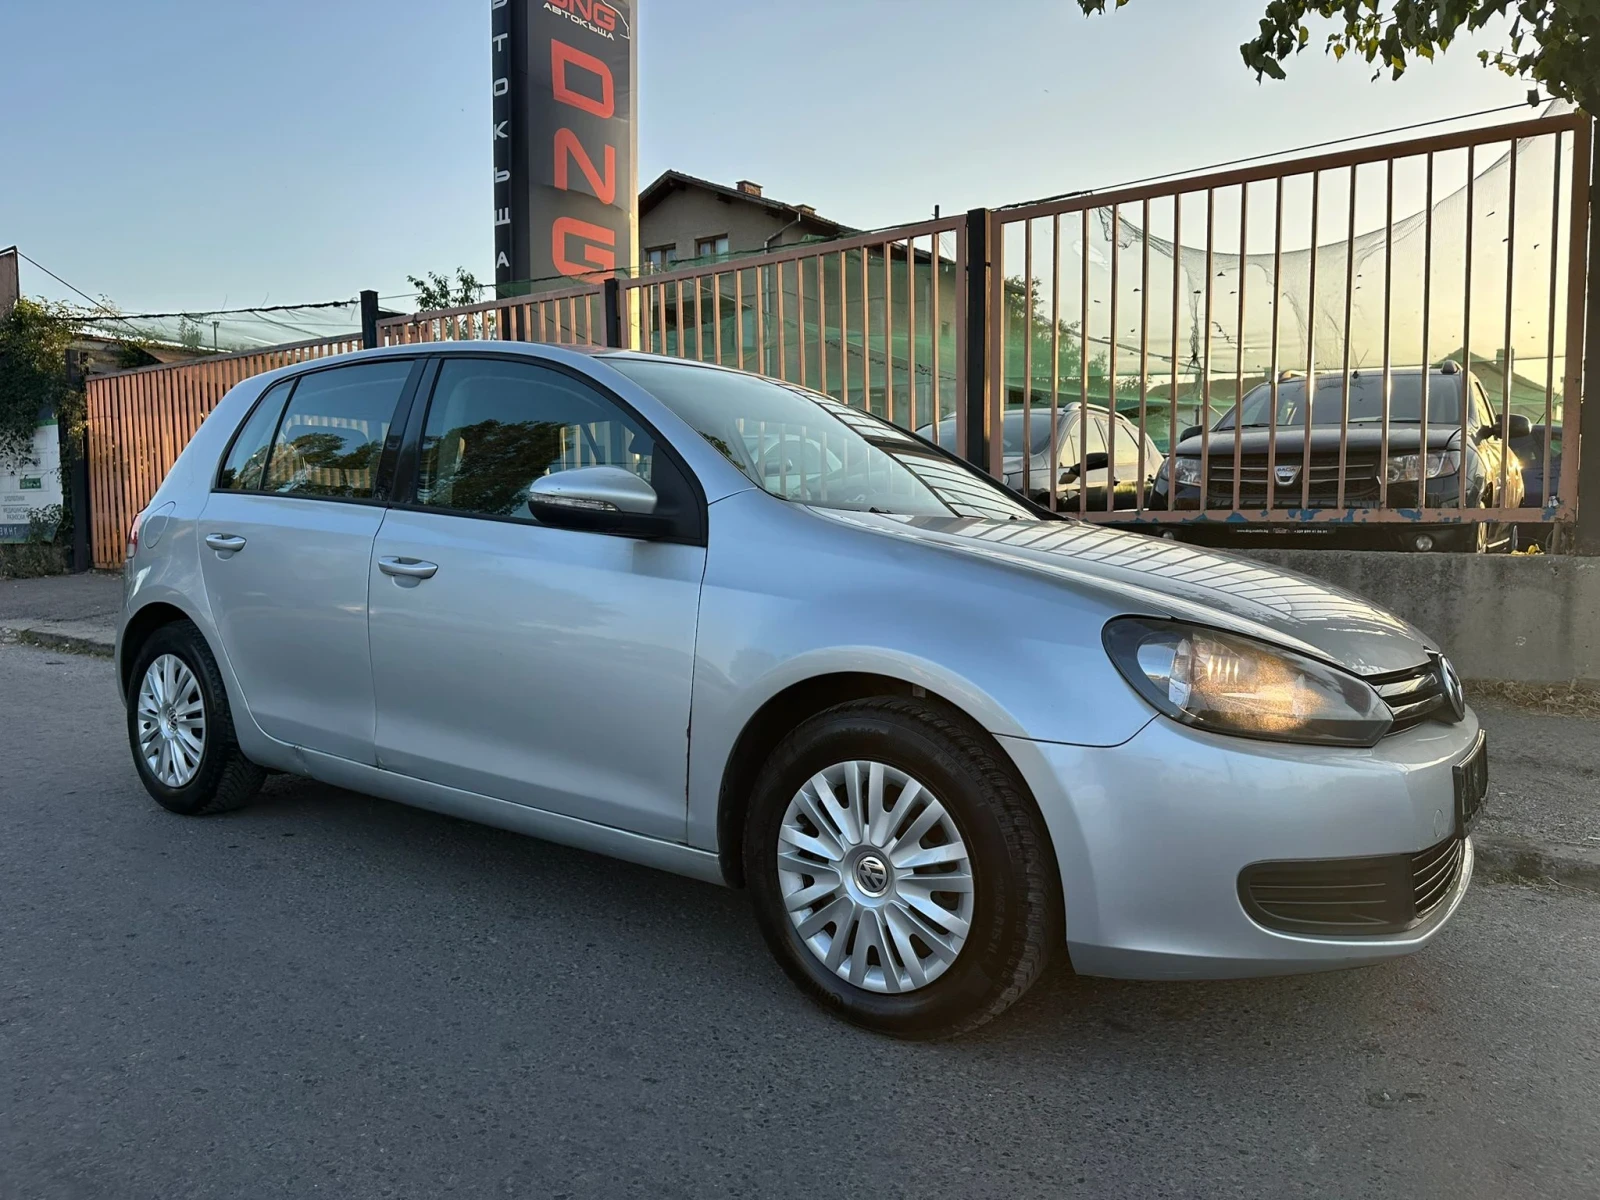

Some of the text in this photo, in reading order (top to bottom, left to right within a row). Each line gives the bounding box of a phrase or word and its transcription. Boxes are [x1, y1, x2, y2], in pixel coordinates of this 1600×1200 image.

[543, 2, 615, 41] АВТОКЪЩА
[548, 0, 616, 32] NG
[550, 38, 616, 285] DNG
